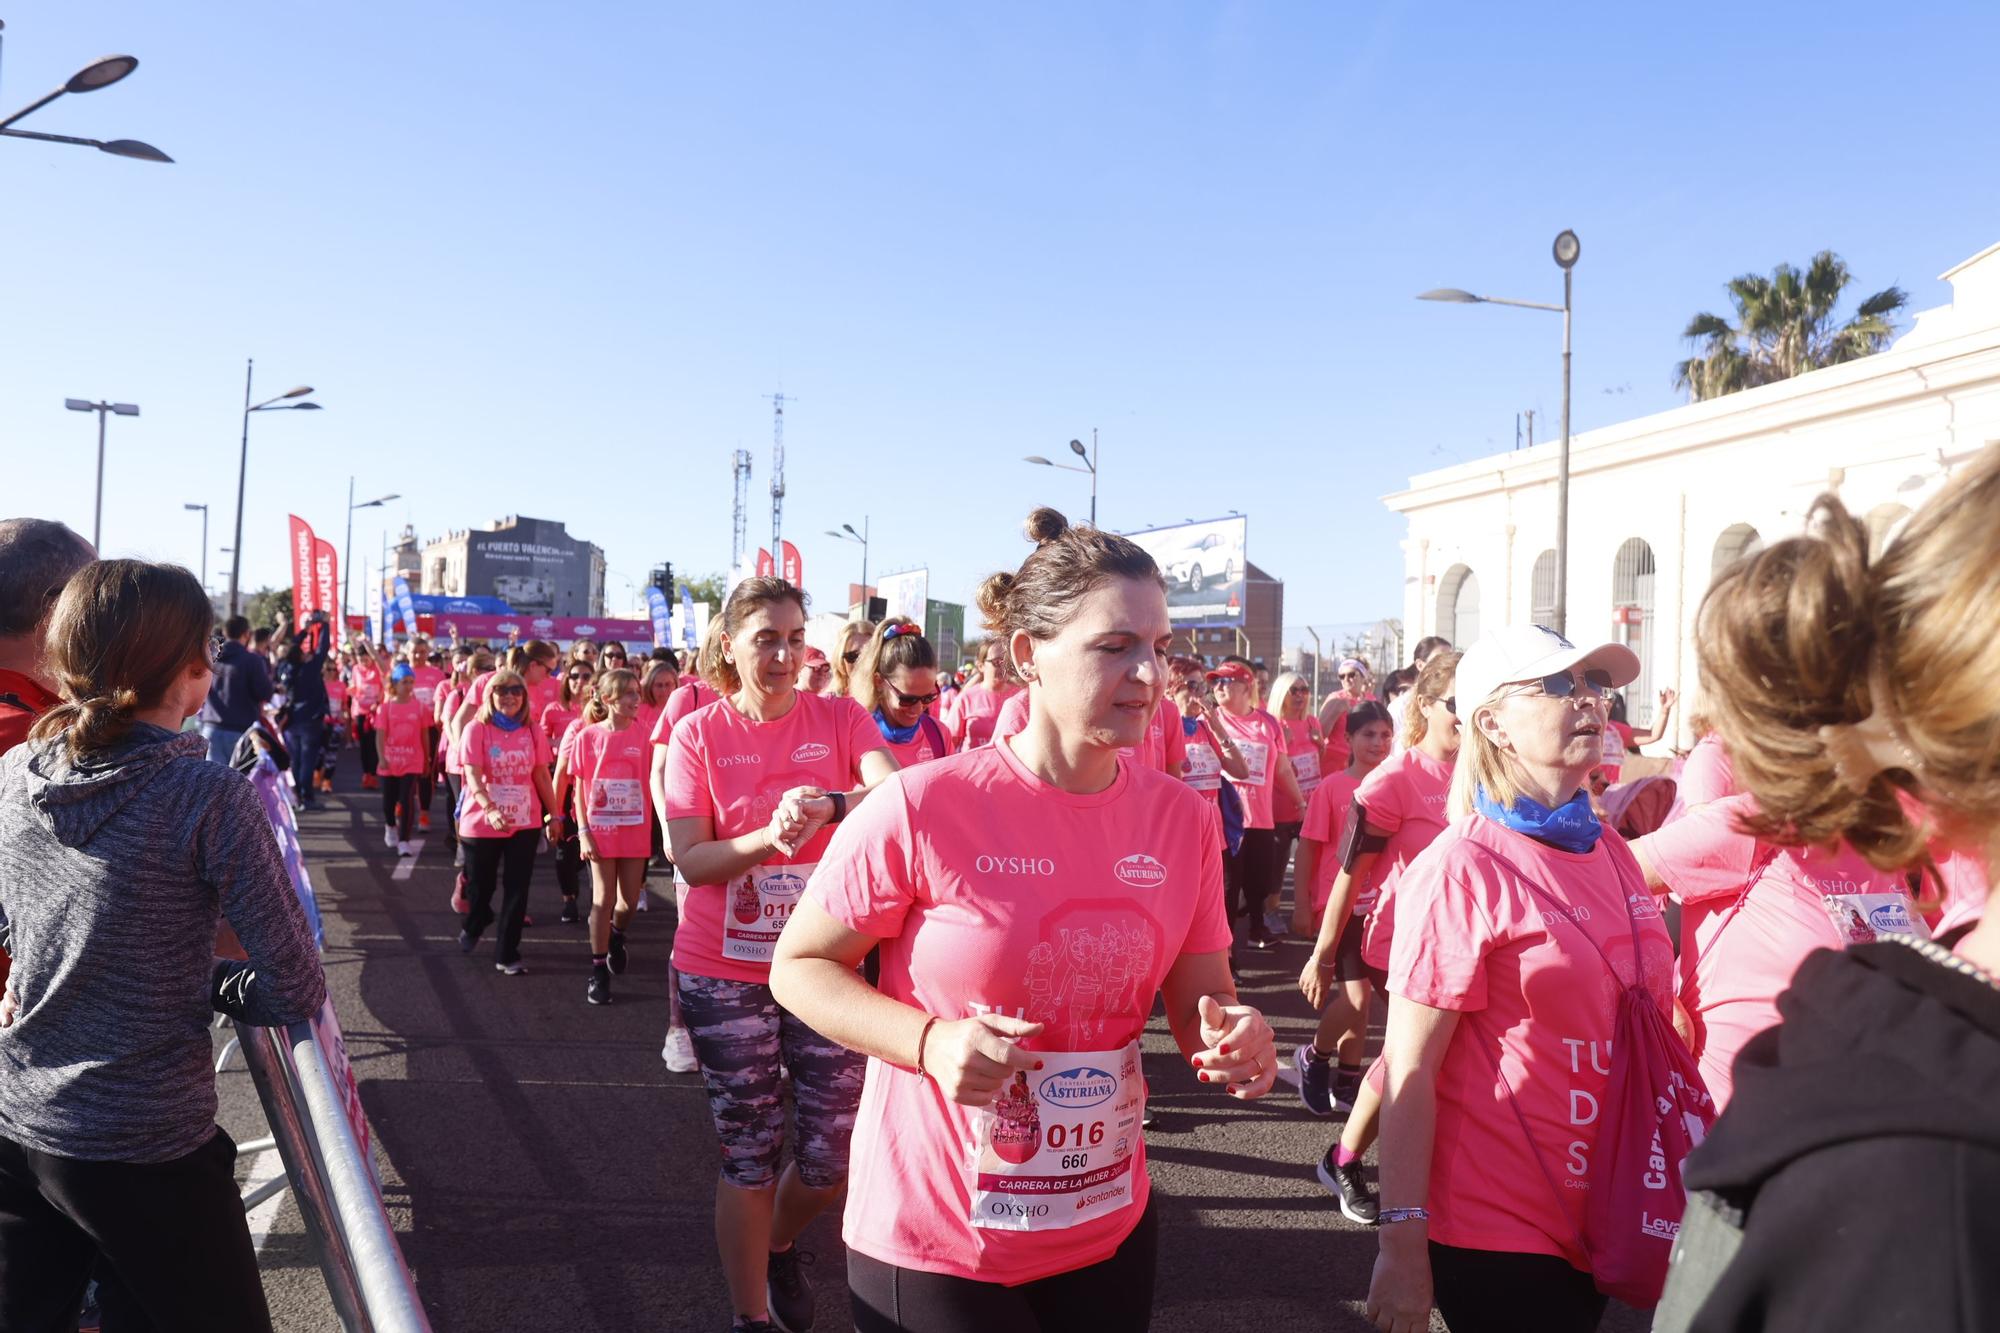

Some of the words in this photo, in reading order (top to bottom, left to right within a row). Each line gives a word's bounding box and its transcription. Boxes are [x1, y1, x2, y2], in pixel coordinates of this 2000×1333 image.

[716, 753, 761, 768] OYSHO
[975, 855, 1055, 876] OYSHO
[737, 931, 767, 940] CARRERA
[733, 944, 767, 955] OYSHO
[1046, 1081, 1112, 1099] ASTURIANA
[1047, 1120, 1105, 1149] 016
[1061, 1152, 1088, 1169] 660
[999, 1179, 1051, 1191] CARRERA
[1053, 1180, 1069, 1191] DE
[1069, 1179, 1082, 1189] LA
[1083, 1170, 1110, 1186] MUJER
[1085, 1185, 1126, 1207] Santander
[991, 1202, 1050, 1218] OYSHO
